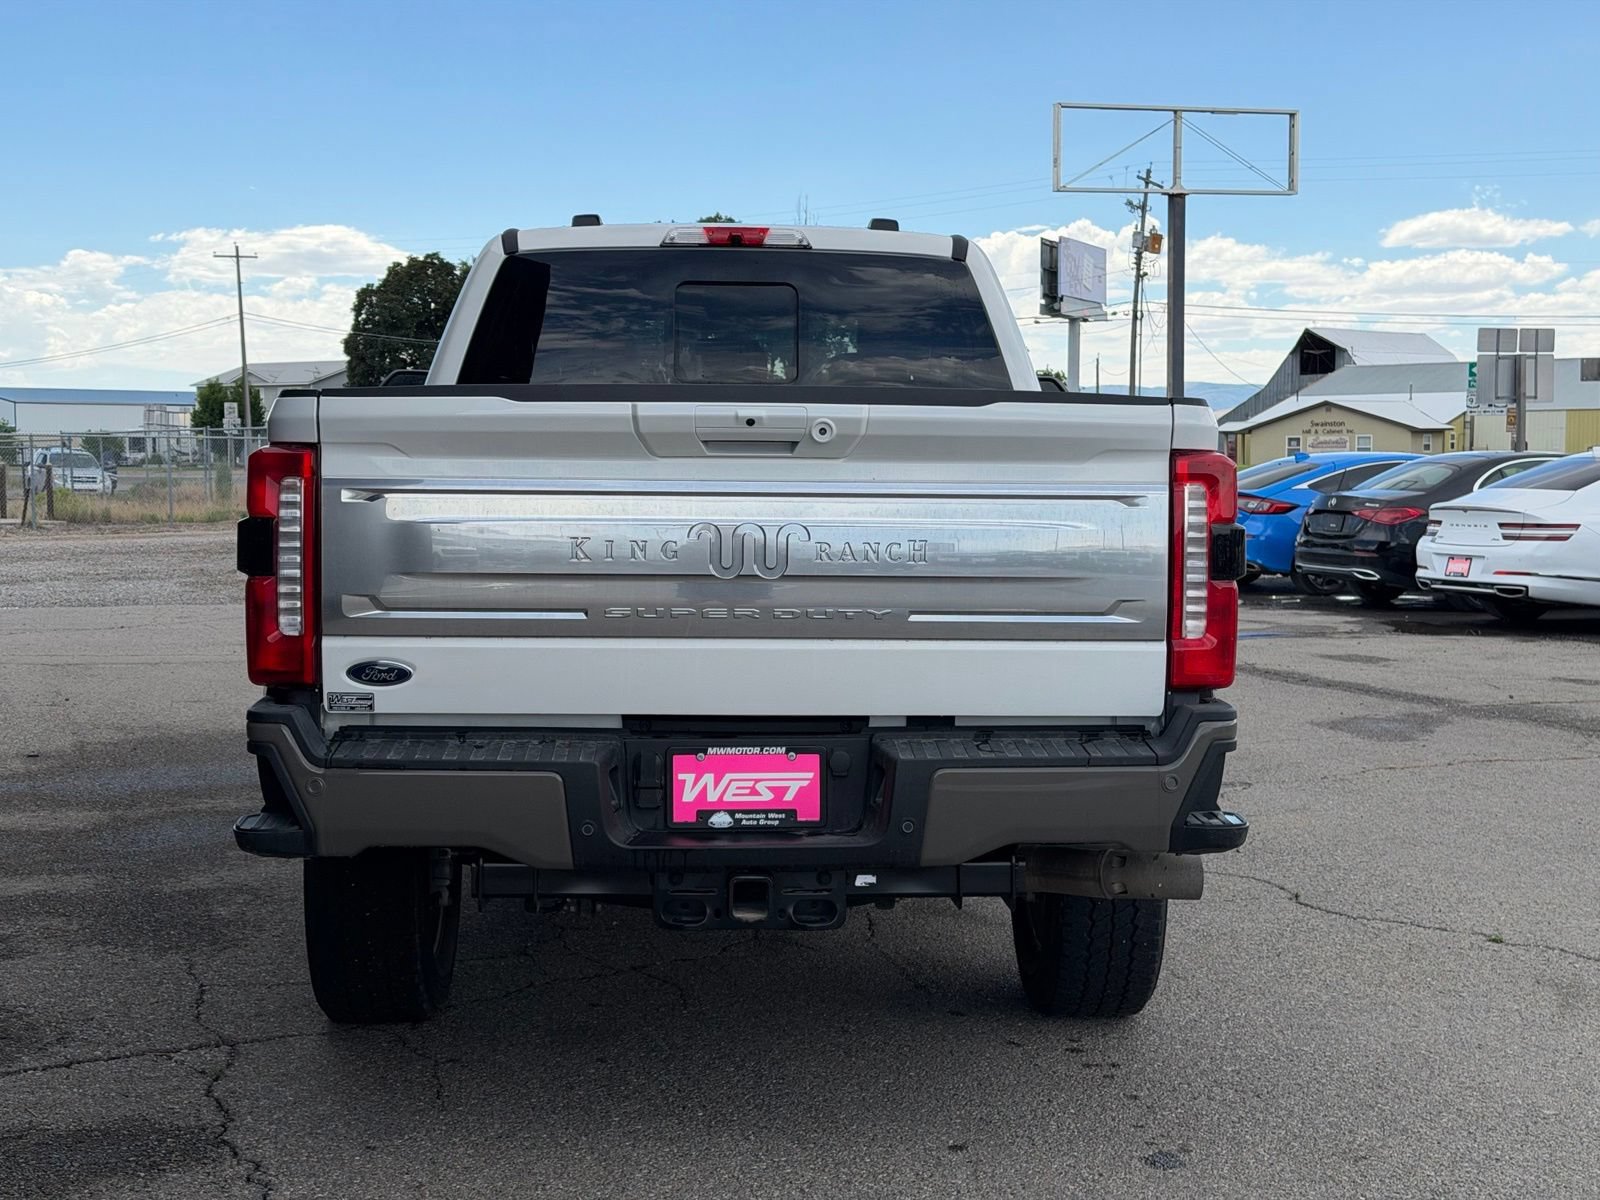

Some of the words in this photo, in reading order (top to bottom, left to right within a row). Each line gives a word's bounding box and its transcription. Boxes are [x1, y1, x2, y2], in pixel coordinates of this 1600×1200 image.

[568, 536, 680, 563] KING
[814, 538, 930, 564] RANCH
[603, 606, 761, 620] SUPER
[772, 607, 894, 621] DUTY
[361, 665, 399, 681] Ford
[707, 746, 787, 755] MWMOTOR.COM
